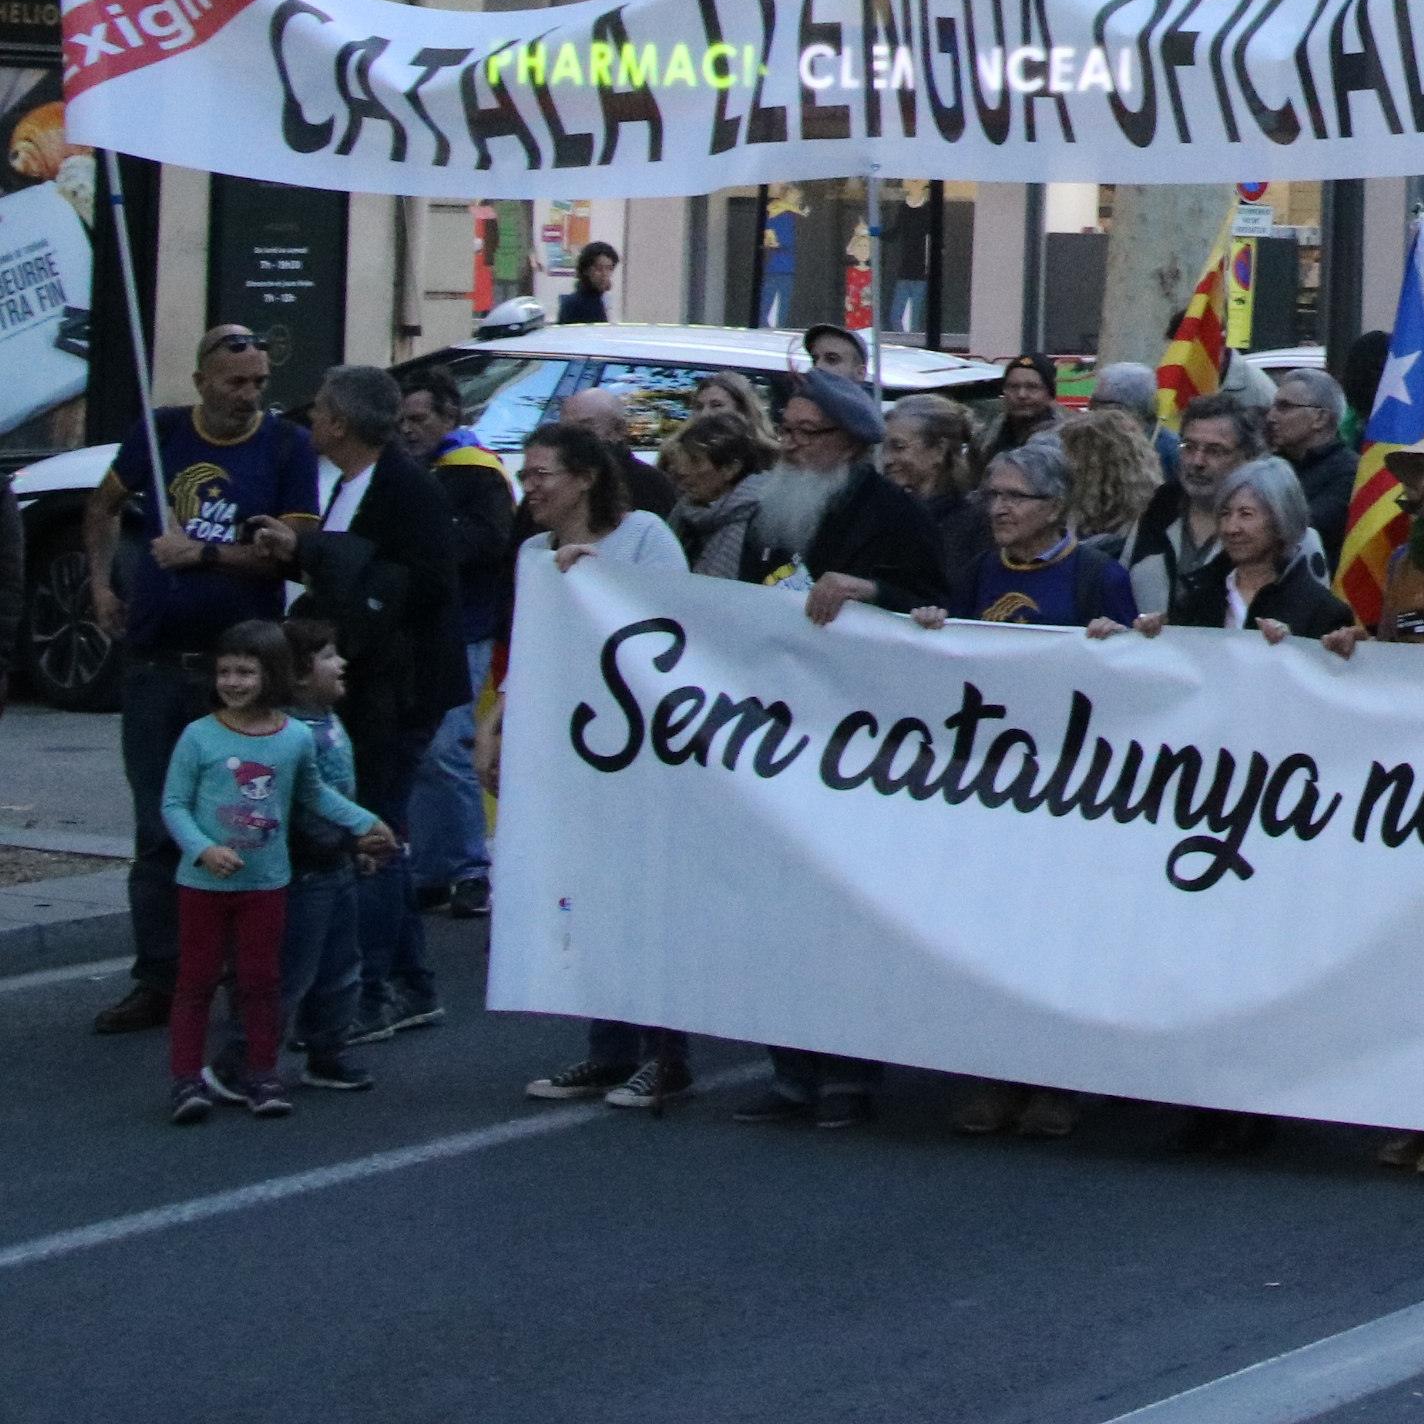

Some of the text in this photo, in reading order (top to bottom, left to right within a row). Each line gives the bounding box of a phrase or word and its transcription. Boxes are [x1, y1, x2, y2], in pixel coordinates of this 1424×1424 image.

[487, 40, 768, 89] PHARMACI
[569, 617, 809, 779] Sem
[820, 681, 1343, 892] catalunya
